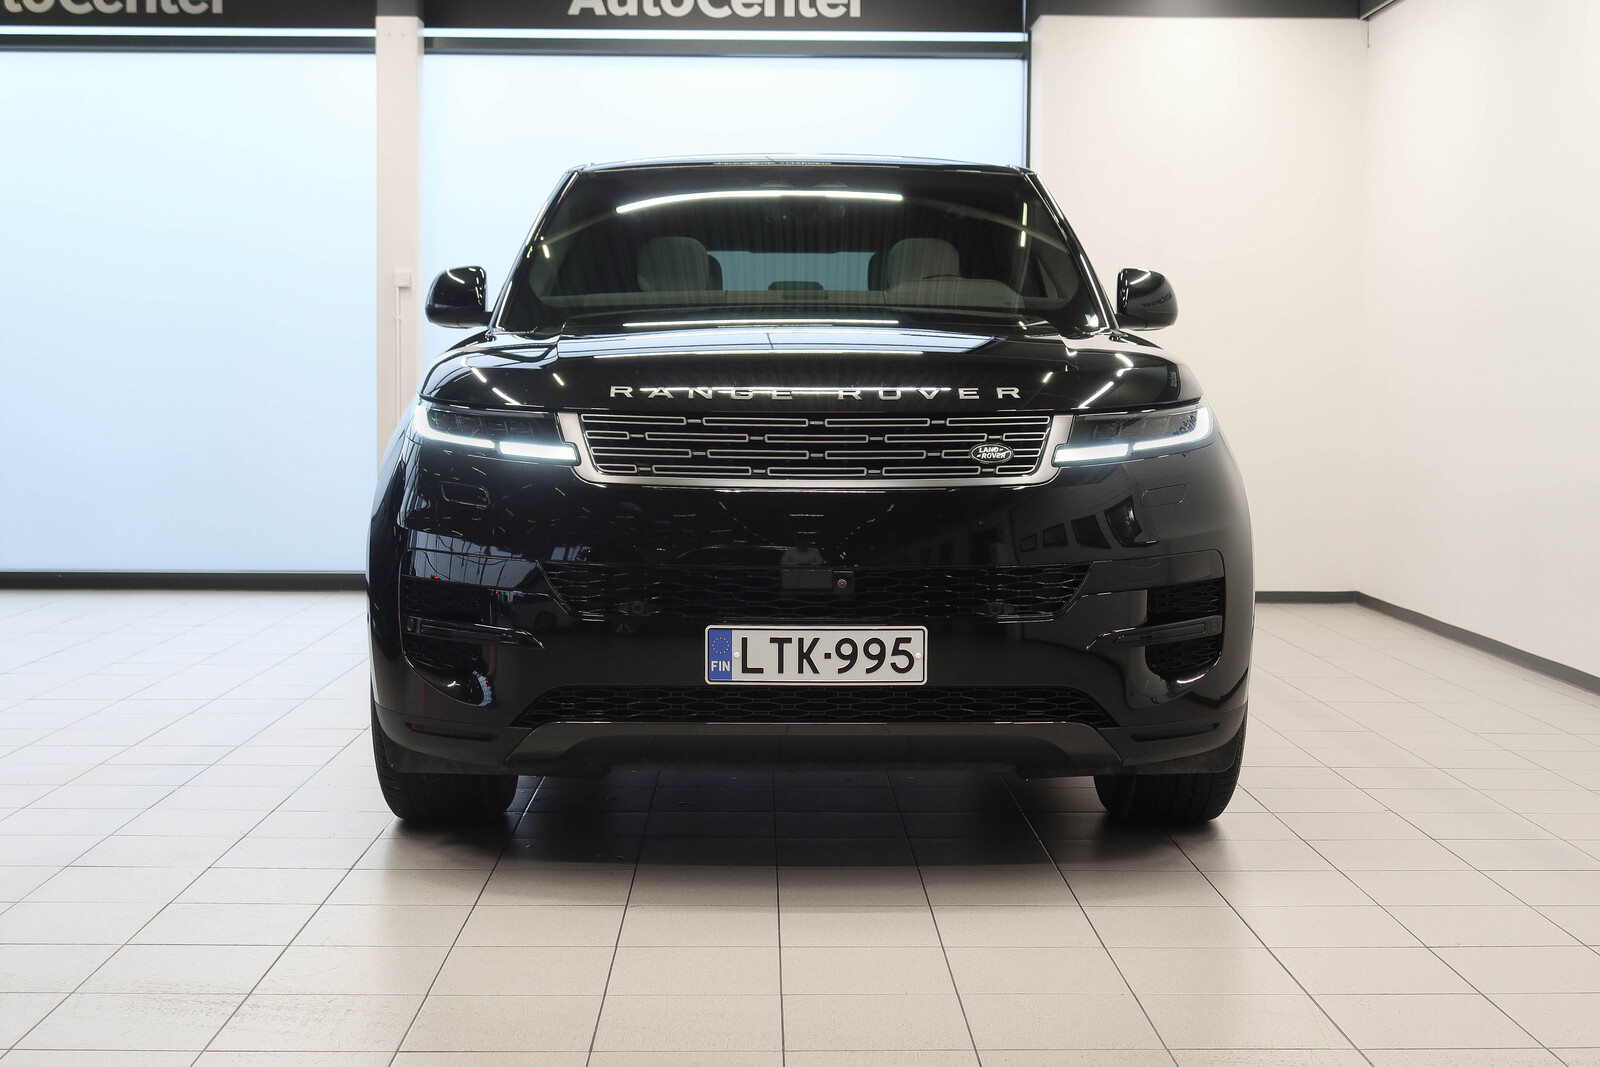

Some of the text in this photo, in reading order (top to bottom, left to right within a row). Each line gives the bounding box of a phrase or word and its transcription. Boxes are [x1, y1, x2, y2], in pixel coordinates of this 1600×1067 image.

[609, 386, 1021, 400] RANGE ROVER
[741, 636, 915, 674] LTK-995
[710, 660, 731, 672] FIN
